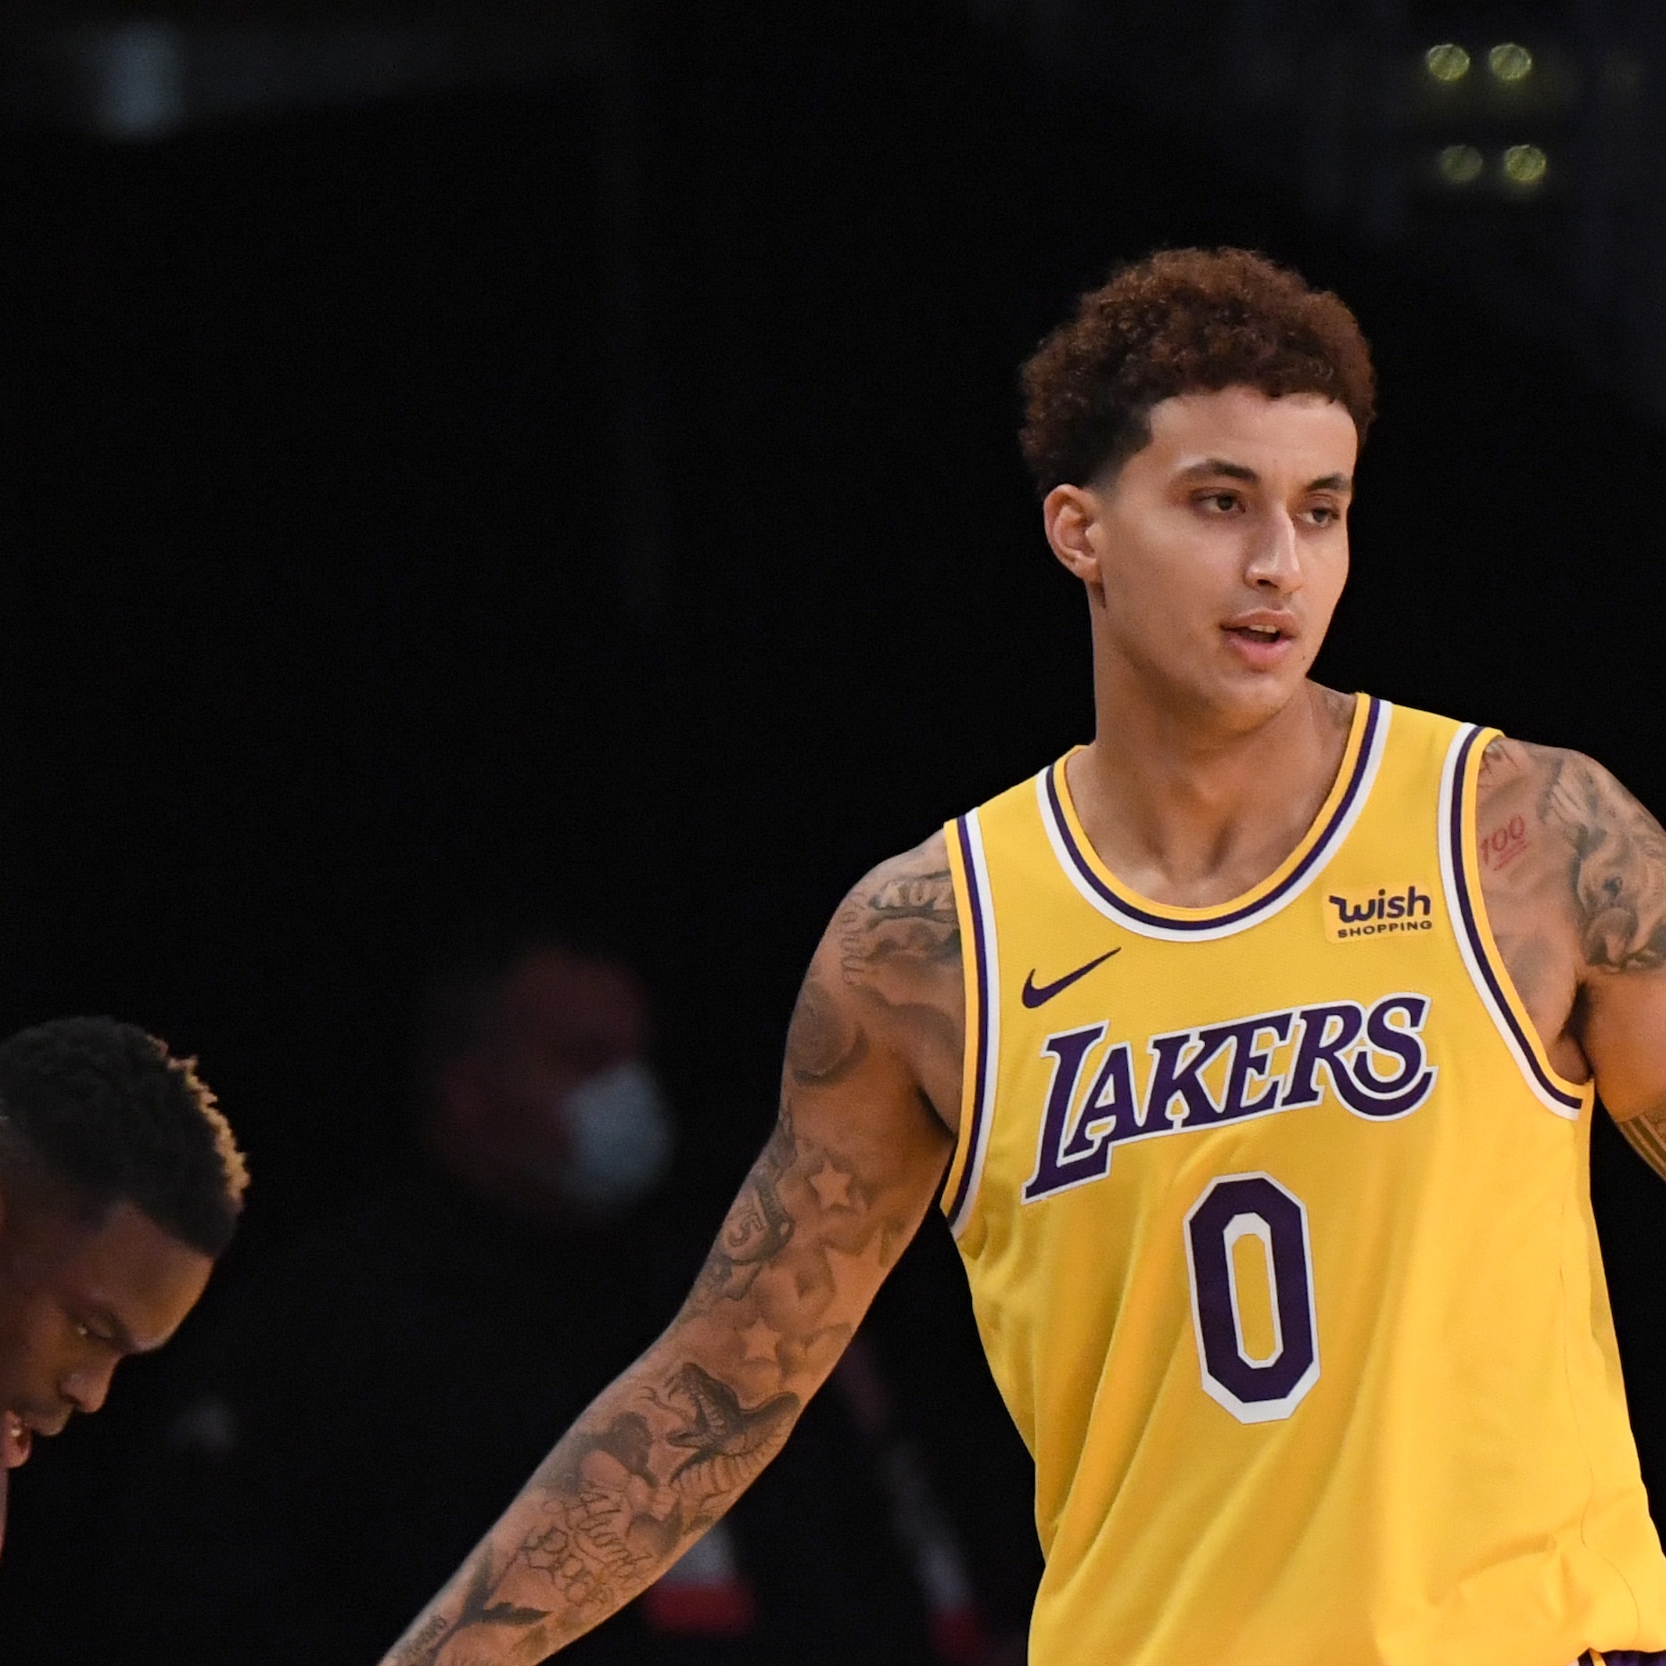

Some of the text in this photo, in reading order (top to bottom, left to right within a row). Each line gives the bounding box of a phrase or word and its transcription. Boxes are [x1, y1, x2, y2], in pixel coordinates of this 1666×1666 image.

[1328, 885, 1431, 924] wish
[1337, 920, 1433, 939] SHOPPING
[1021, 992, 1438, 1205] LAKERS
[1183, 1171, 1320, 1425] 0
